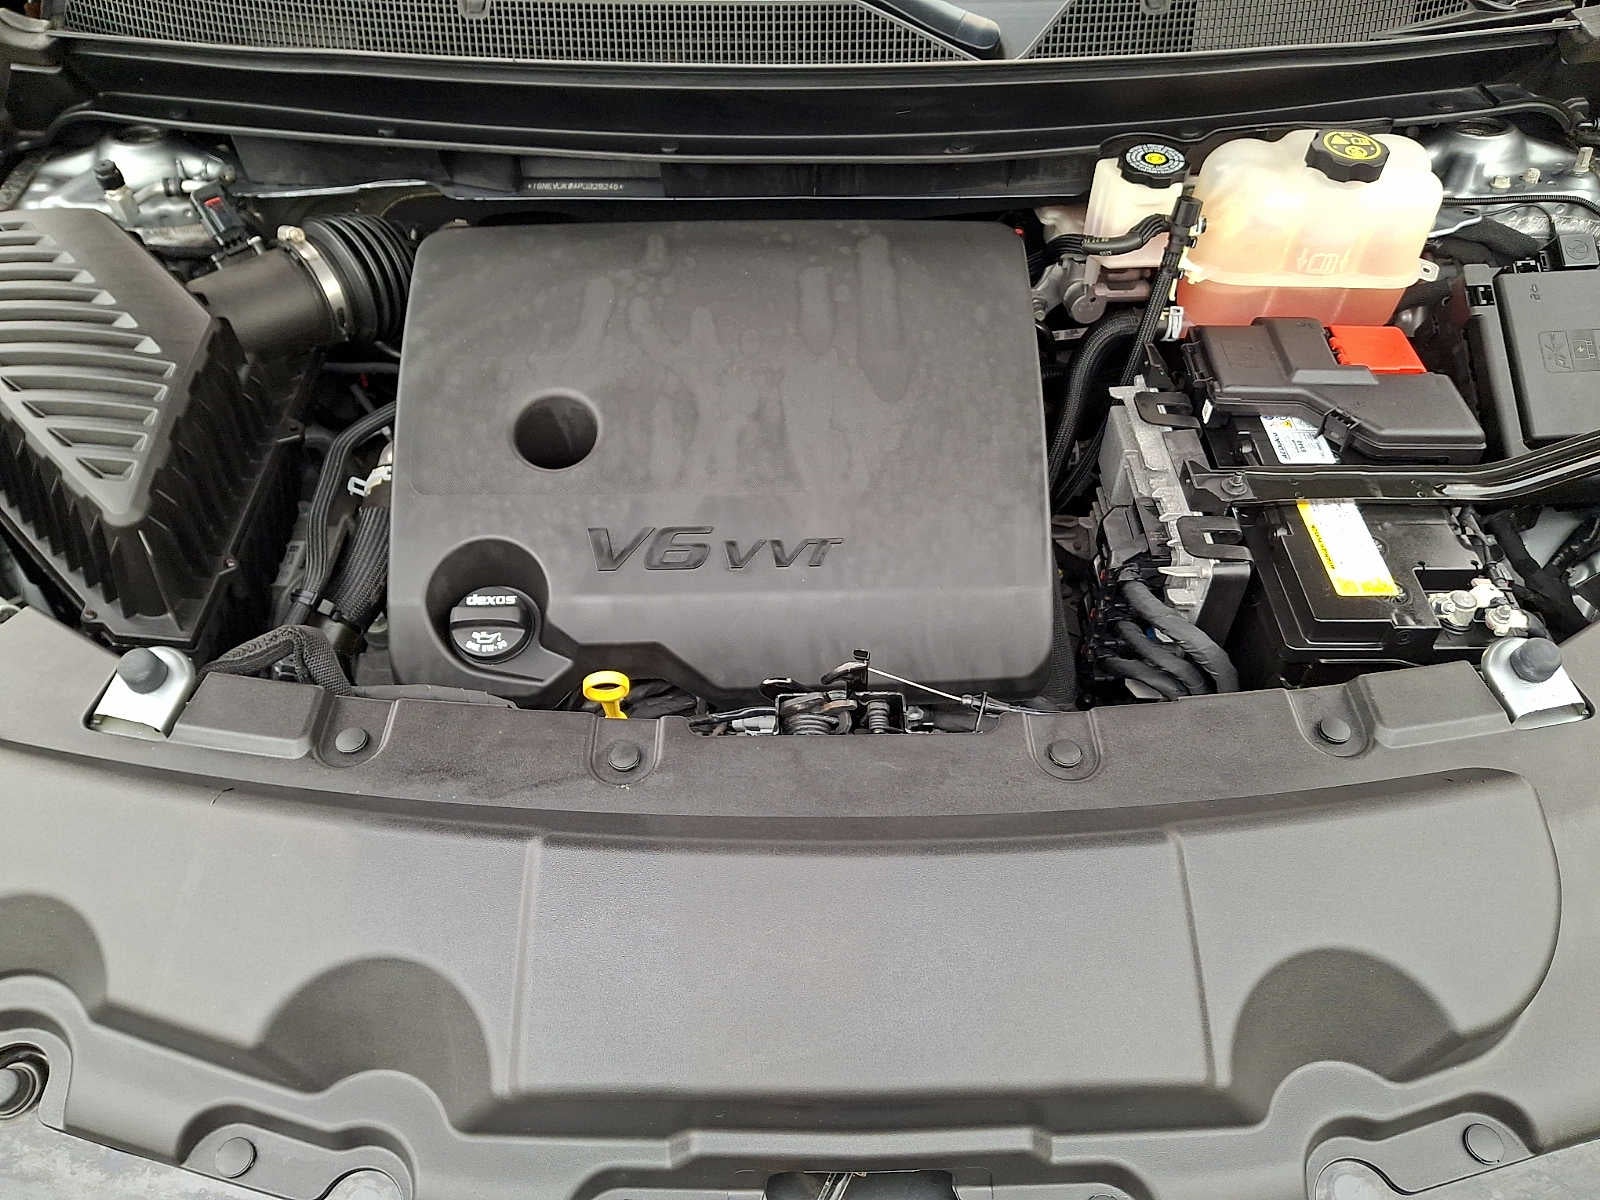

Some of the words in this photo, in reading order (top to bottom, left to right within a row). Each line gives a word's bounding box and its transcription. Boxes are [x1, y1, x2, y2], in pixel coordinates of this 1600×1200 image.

[587, 526, 714, 572] V6
[724, 537, 846, 569] VVT
[465, 593, 518, 606] dexos
